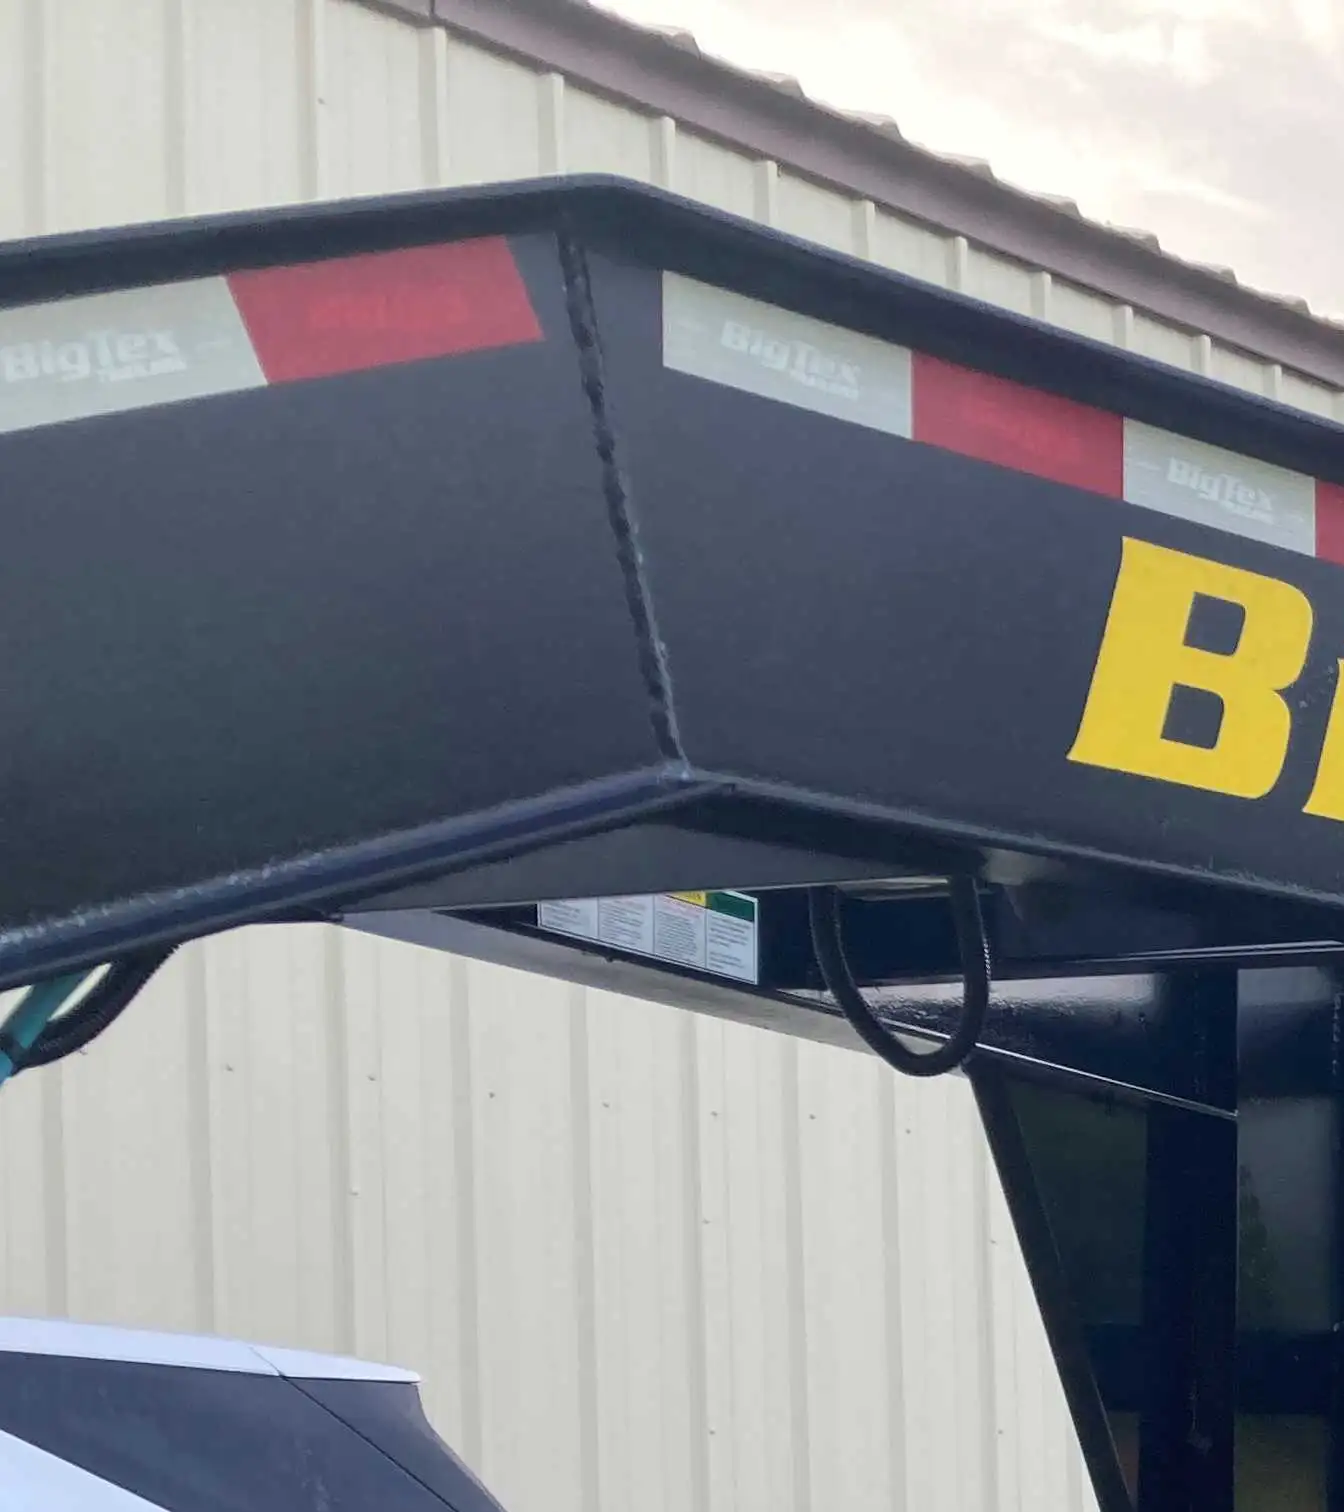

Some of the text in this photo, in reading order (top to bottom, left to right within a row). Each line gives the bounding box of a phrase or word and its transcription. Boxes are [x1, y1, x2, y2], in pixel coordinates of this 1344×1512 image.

[2, 328, 180, 383] BigTex
[719, 319, 862, 386] BigTex
[1167, 456, 1274, 512] BigTex
